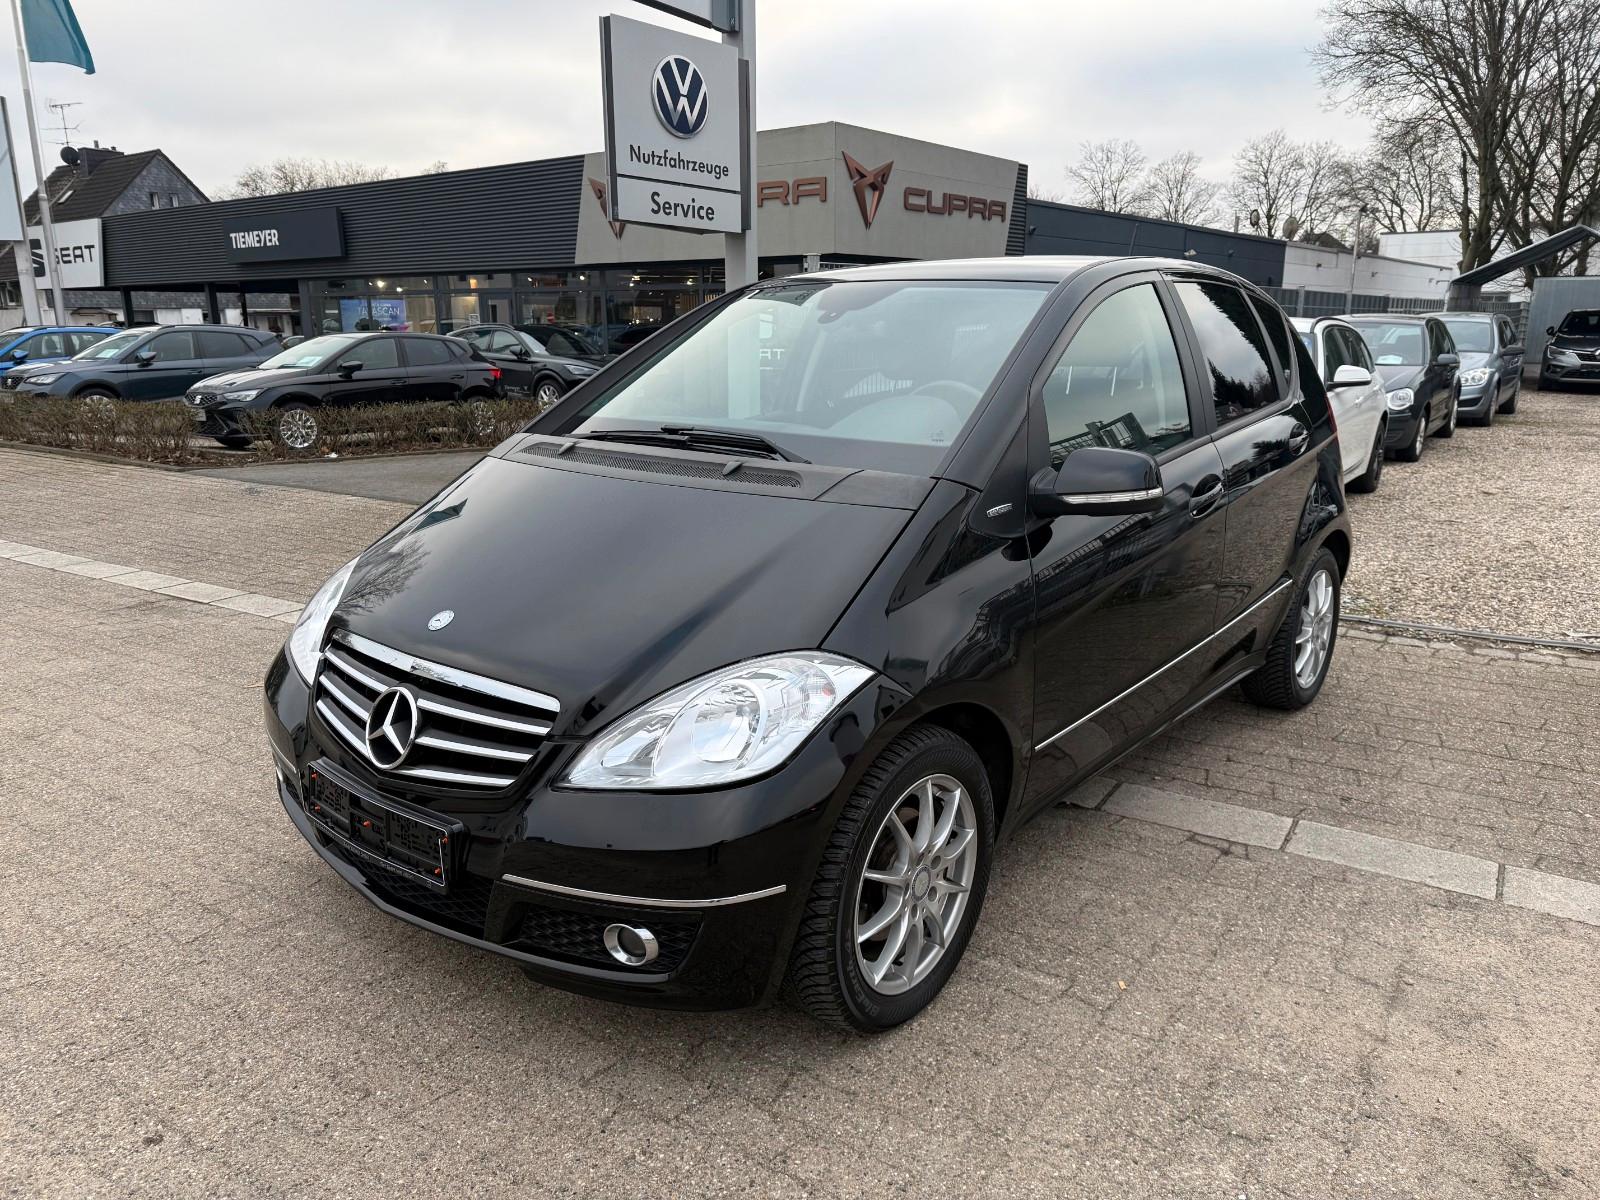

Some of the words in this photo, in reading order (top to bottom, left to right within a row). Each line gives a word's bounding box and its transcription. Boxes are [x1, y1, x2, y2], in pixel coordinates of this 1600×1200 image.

[629, 143, 729, 180] Nutzfahrzeuge
[650, 191, 715, 221] Service
[903, 186, 1007, 223] CUPRA
[229, 229, 280, 249] TIEMEYER
[358, 306, 400, 316] TAASCAN
